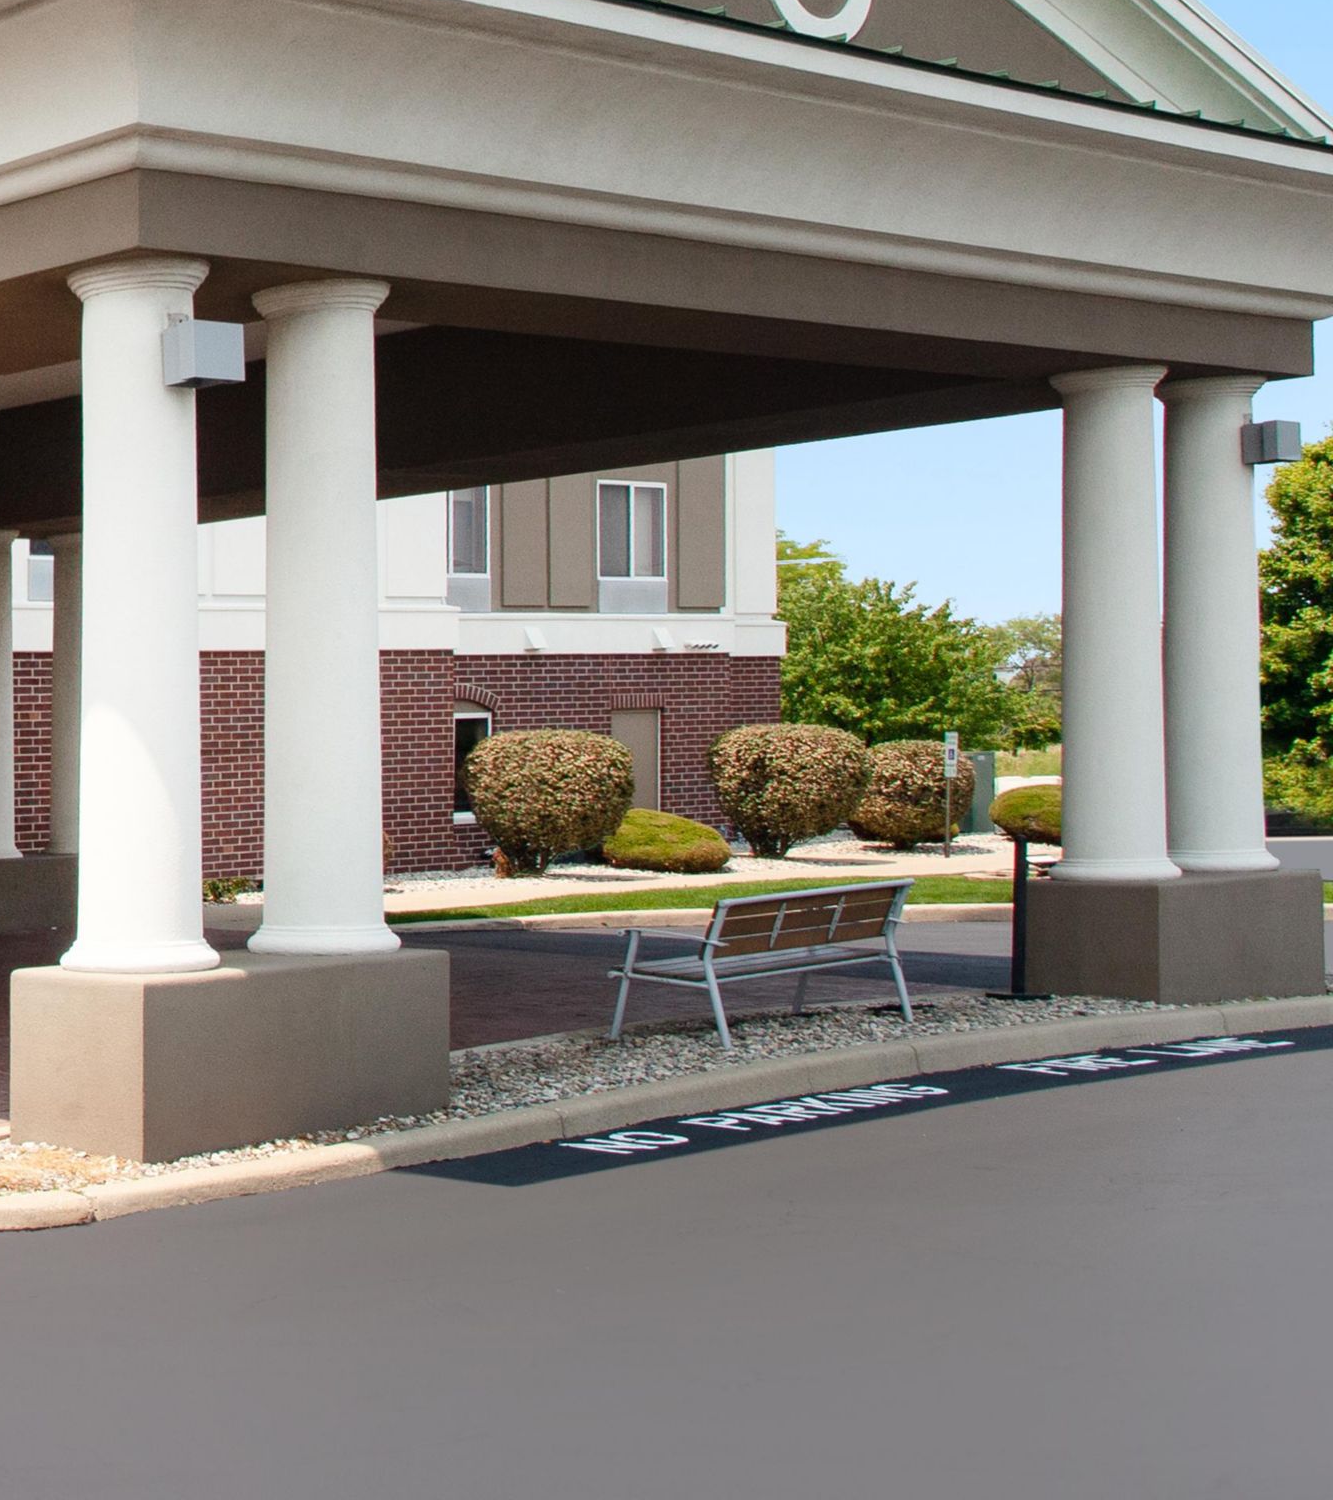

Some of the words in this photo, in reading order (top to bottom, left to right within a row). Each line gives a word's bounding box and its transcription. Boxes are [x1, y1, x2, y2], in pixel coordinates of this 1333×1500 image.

[558, 1130, 690, 1154] NO
[678, 1083, 949, 1131] PARKING
[996, 1054, 1159, 1075] FIRE
[1126, 1037, 1295, 1057] LANE
